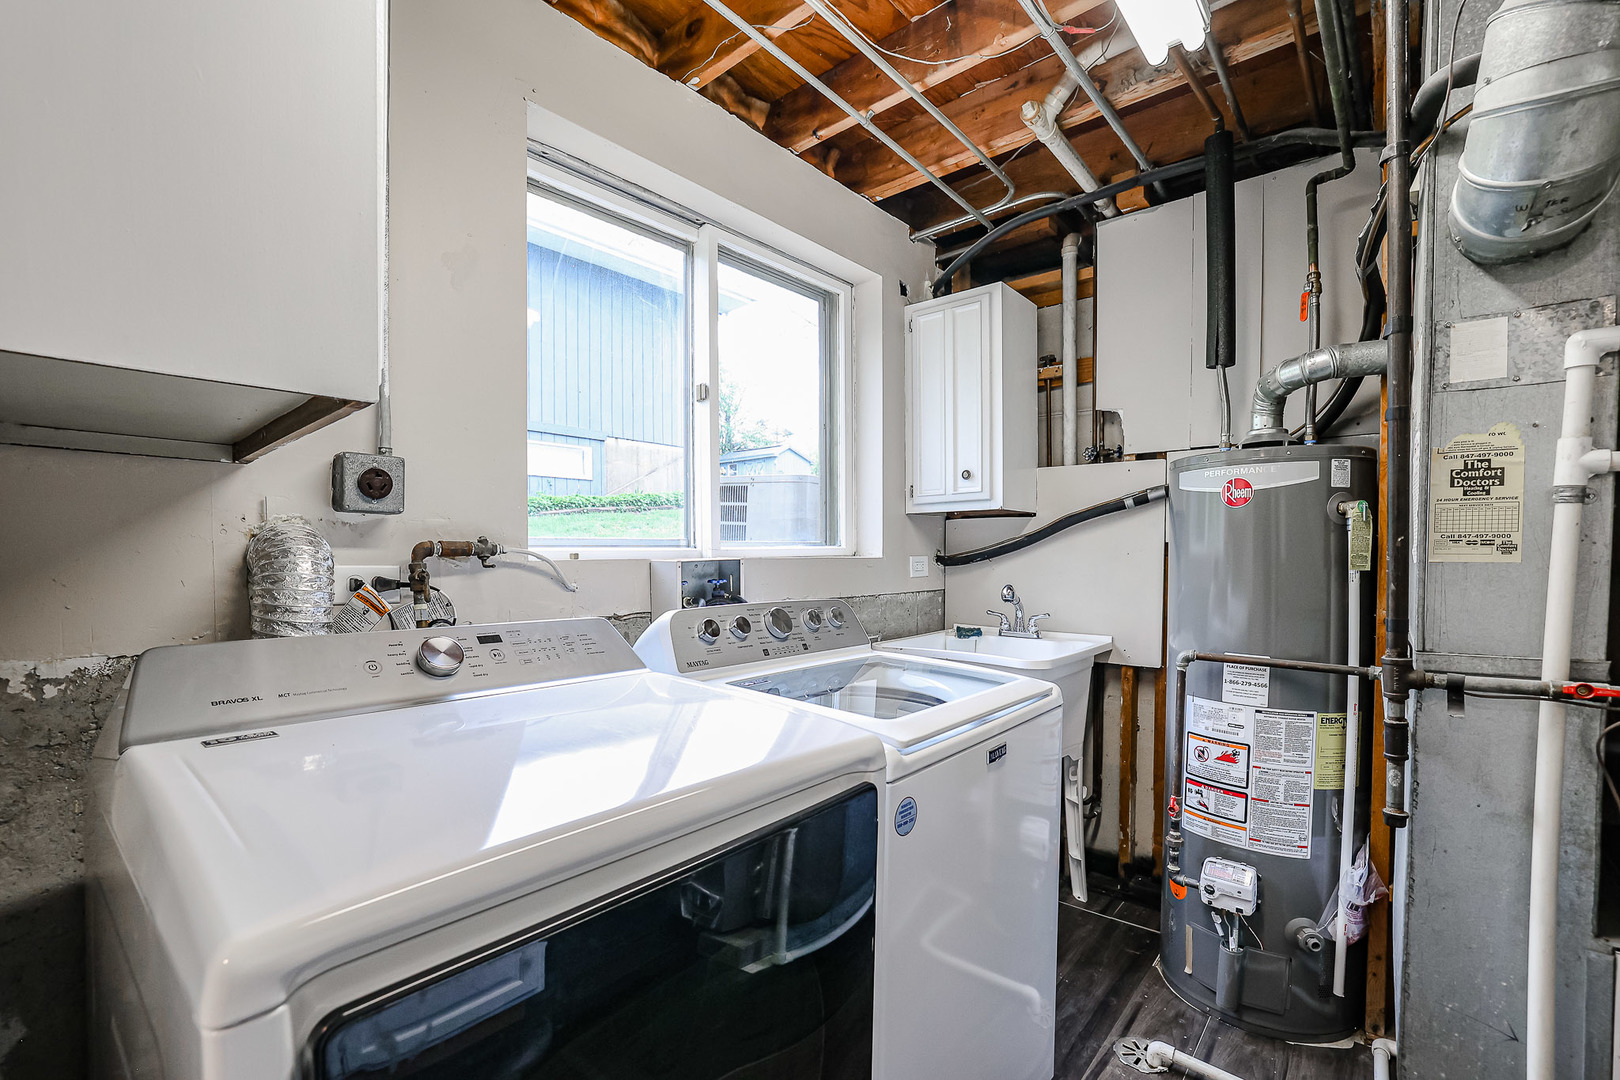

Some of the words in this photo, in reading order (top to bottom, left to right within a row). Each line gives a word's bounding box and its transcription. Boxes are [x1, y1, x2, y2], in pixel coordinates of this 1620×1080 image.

[1460, 451, 1514, 459] 847-497-9000
[1465, 460, 1489, 469] The
[1451, 468, 1502, 478] Comfort
[1454, 478, 1501, 487] Doctors
[1225, 478, 1252, 503] Rheem
[686, 659, 710, 668] MAYTAG
[1224, 678, 1268, 688] 1-866-279-4566
[210, 697, 250, 706] BRAVOS
